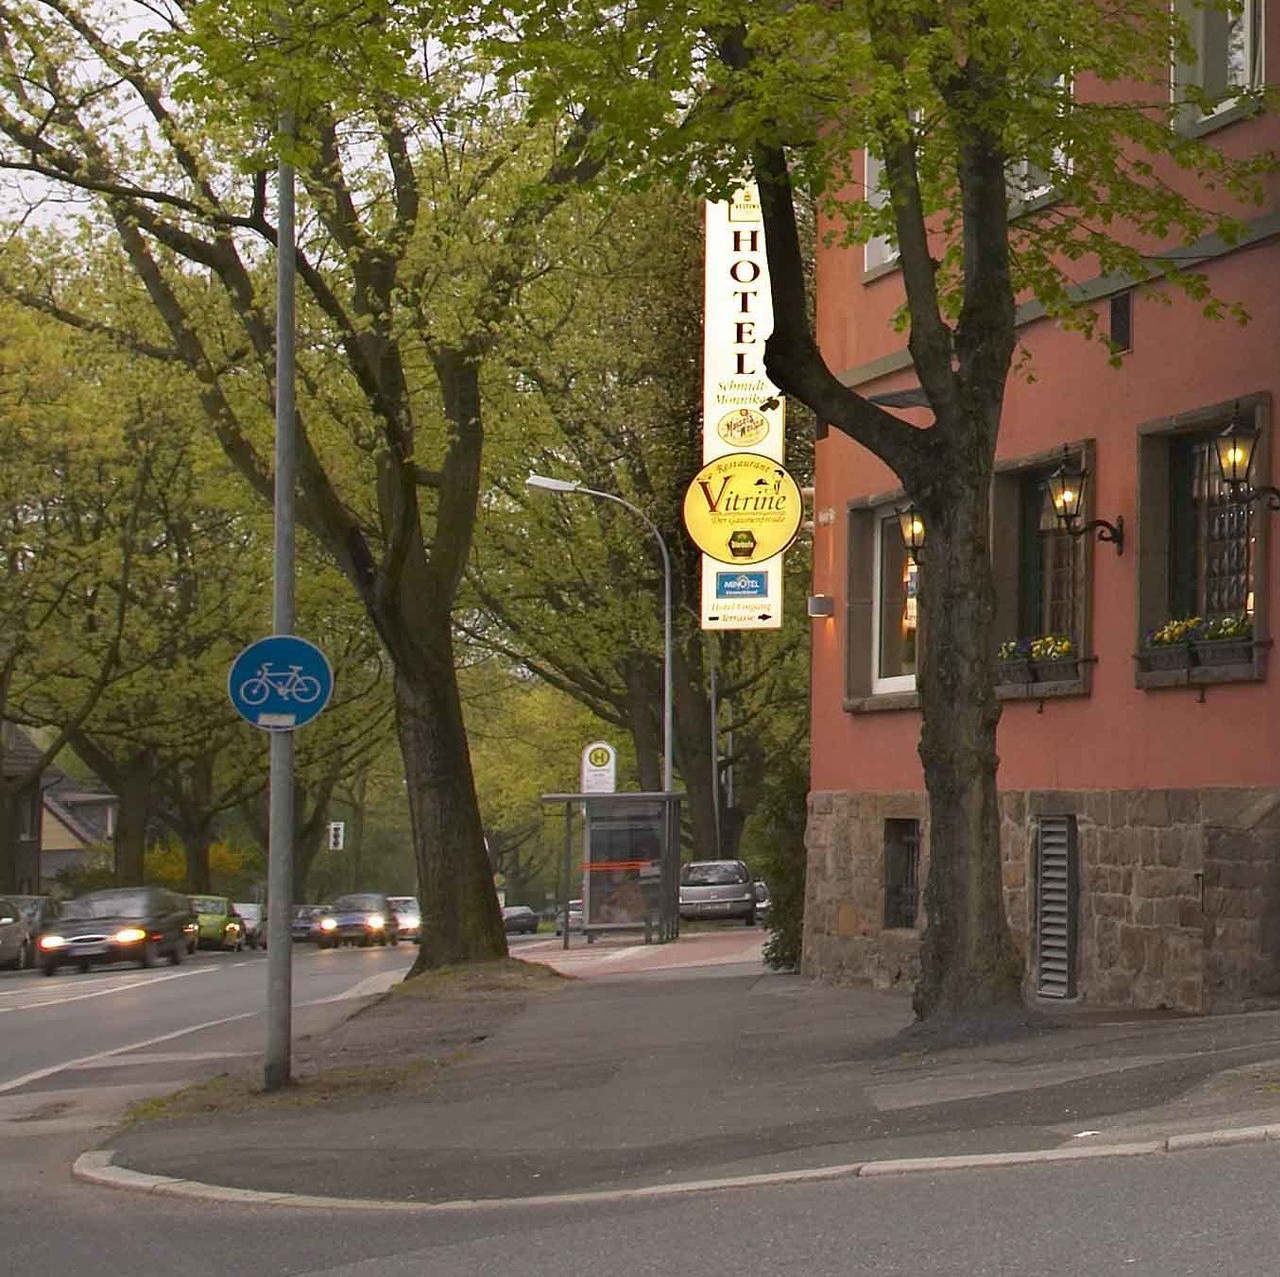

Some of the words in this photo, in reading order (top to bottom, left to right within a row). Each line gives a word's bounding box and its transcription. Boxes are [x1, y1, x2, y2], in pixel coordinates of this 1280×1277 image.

[730, 230, 760, 375] HOTEL
[716, 461, 771, 474] Restaurant
[698, 474, 787, 513] Vitrine
